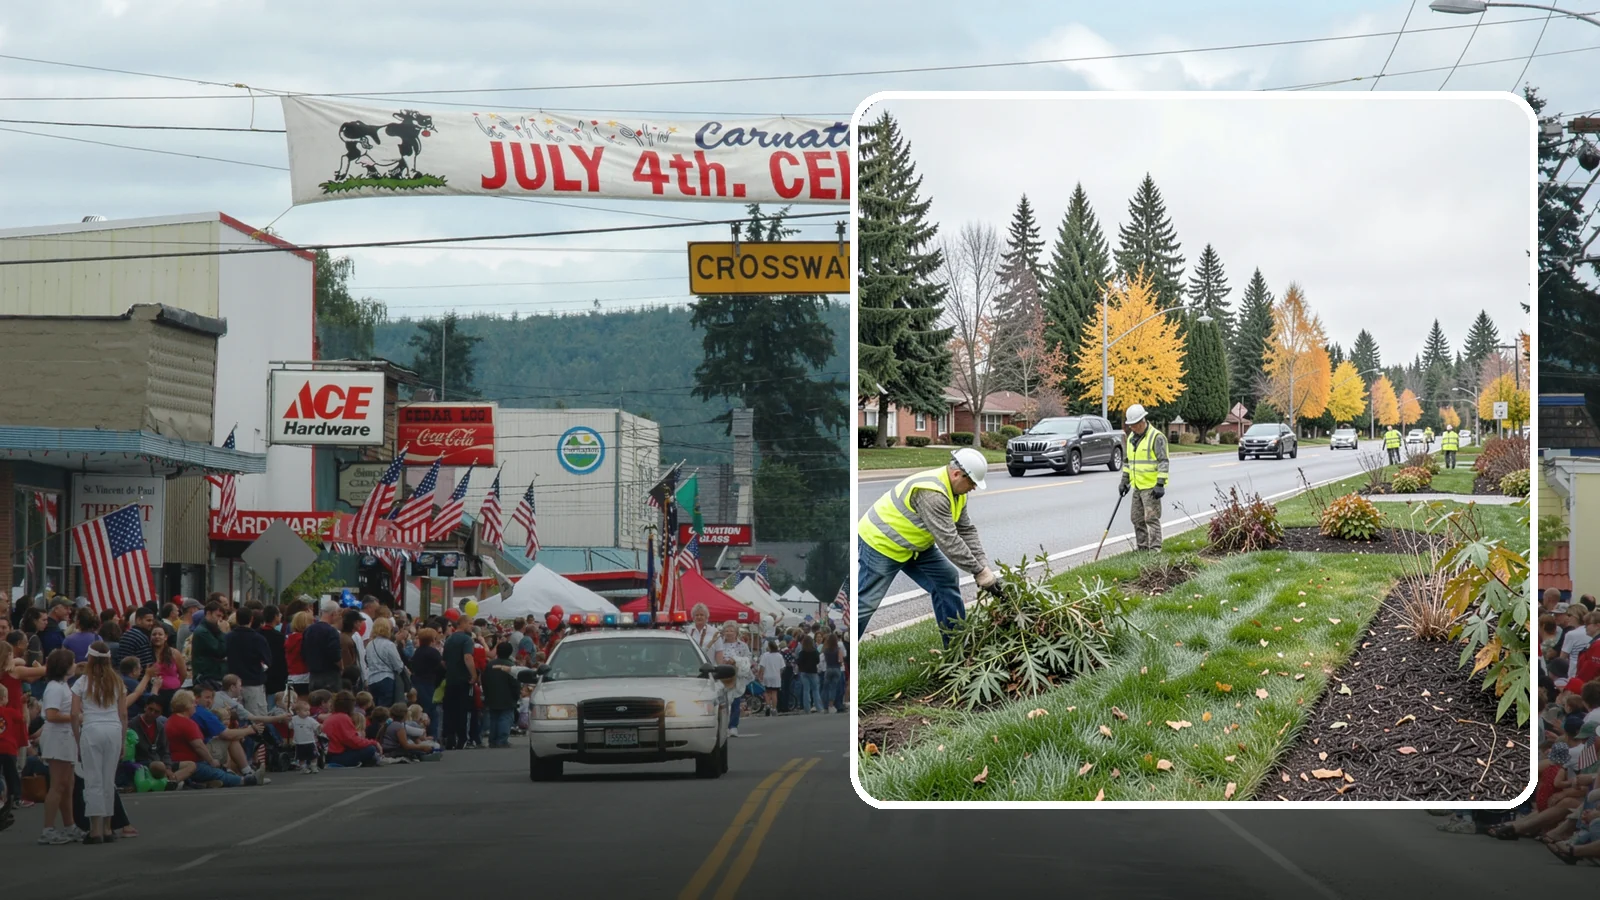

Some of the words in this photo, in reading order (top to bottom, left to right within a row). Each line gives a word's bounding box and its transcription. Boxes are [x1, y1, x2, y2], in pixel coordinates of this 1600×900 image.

[481, 141, 605, 192] JULY
[632, 150, 746, 198] 4th.
[697, 254, 850, 280] CROSSWA
[283, 380, 374, 420] ACE
[405, 409, 453, 422] CEDAR
[283, 421, 371, 437] Hardware
[416, 428, 477, 447] Coca-Cola
[353, 466, 386, 482] Simpl
[83, 485, 93, 494] St.
[95, 485, 124, 495] Vincent
[126, 486, 136, 495] de
[137, 486, 155, 495] Paul
[688, 526, 741, 535] CRNATION
[699, 535, 730, 543] GLASS
